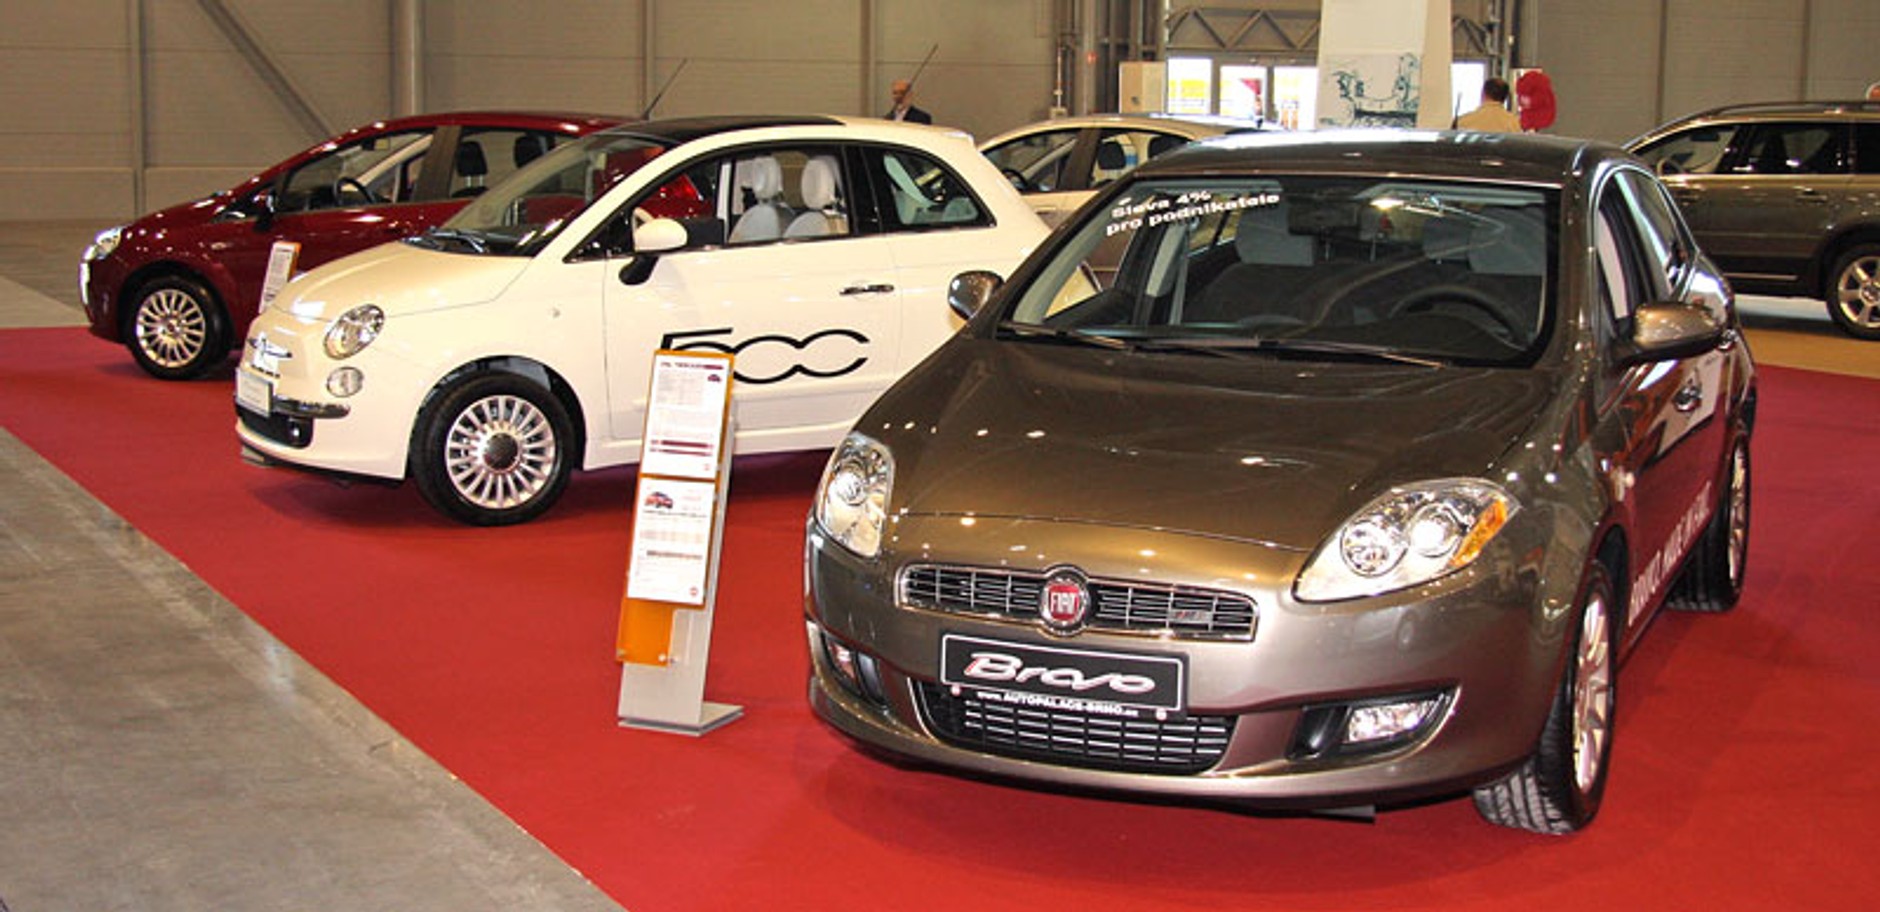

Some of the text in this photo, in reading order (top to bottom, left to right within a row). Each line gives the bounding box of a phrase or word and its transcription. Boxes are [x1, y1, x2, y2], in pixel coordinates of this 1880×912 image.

[1176, 190, 1211, 203] 4%
[1107, 218, 1142, 236] pro
[1050, 592, 1078, 614] FIAT
[964, 653, 1156, 694] Bravo
